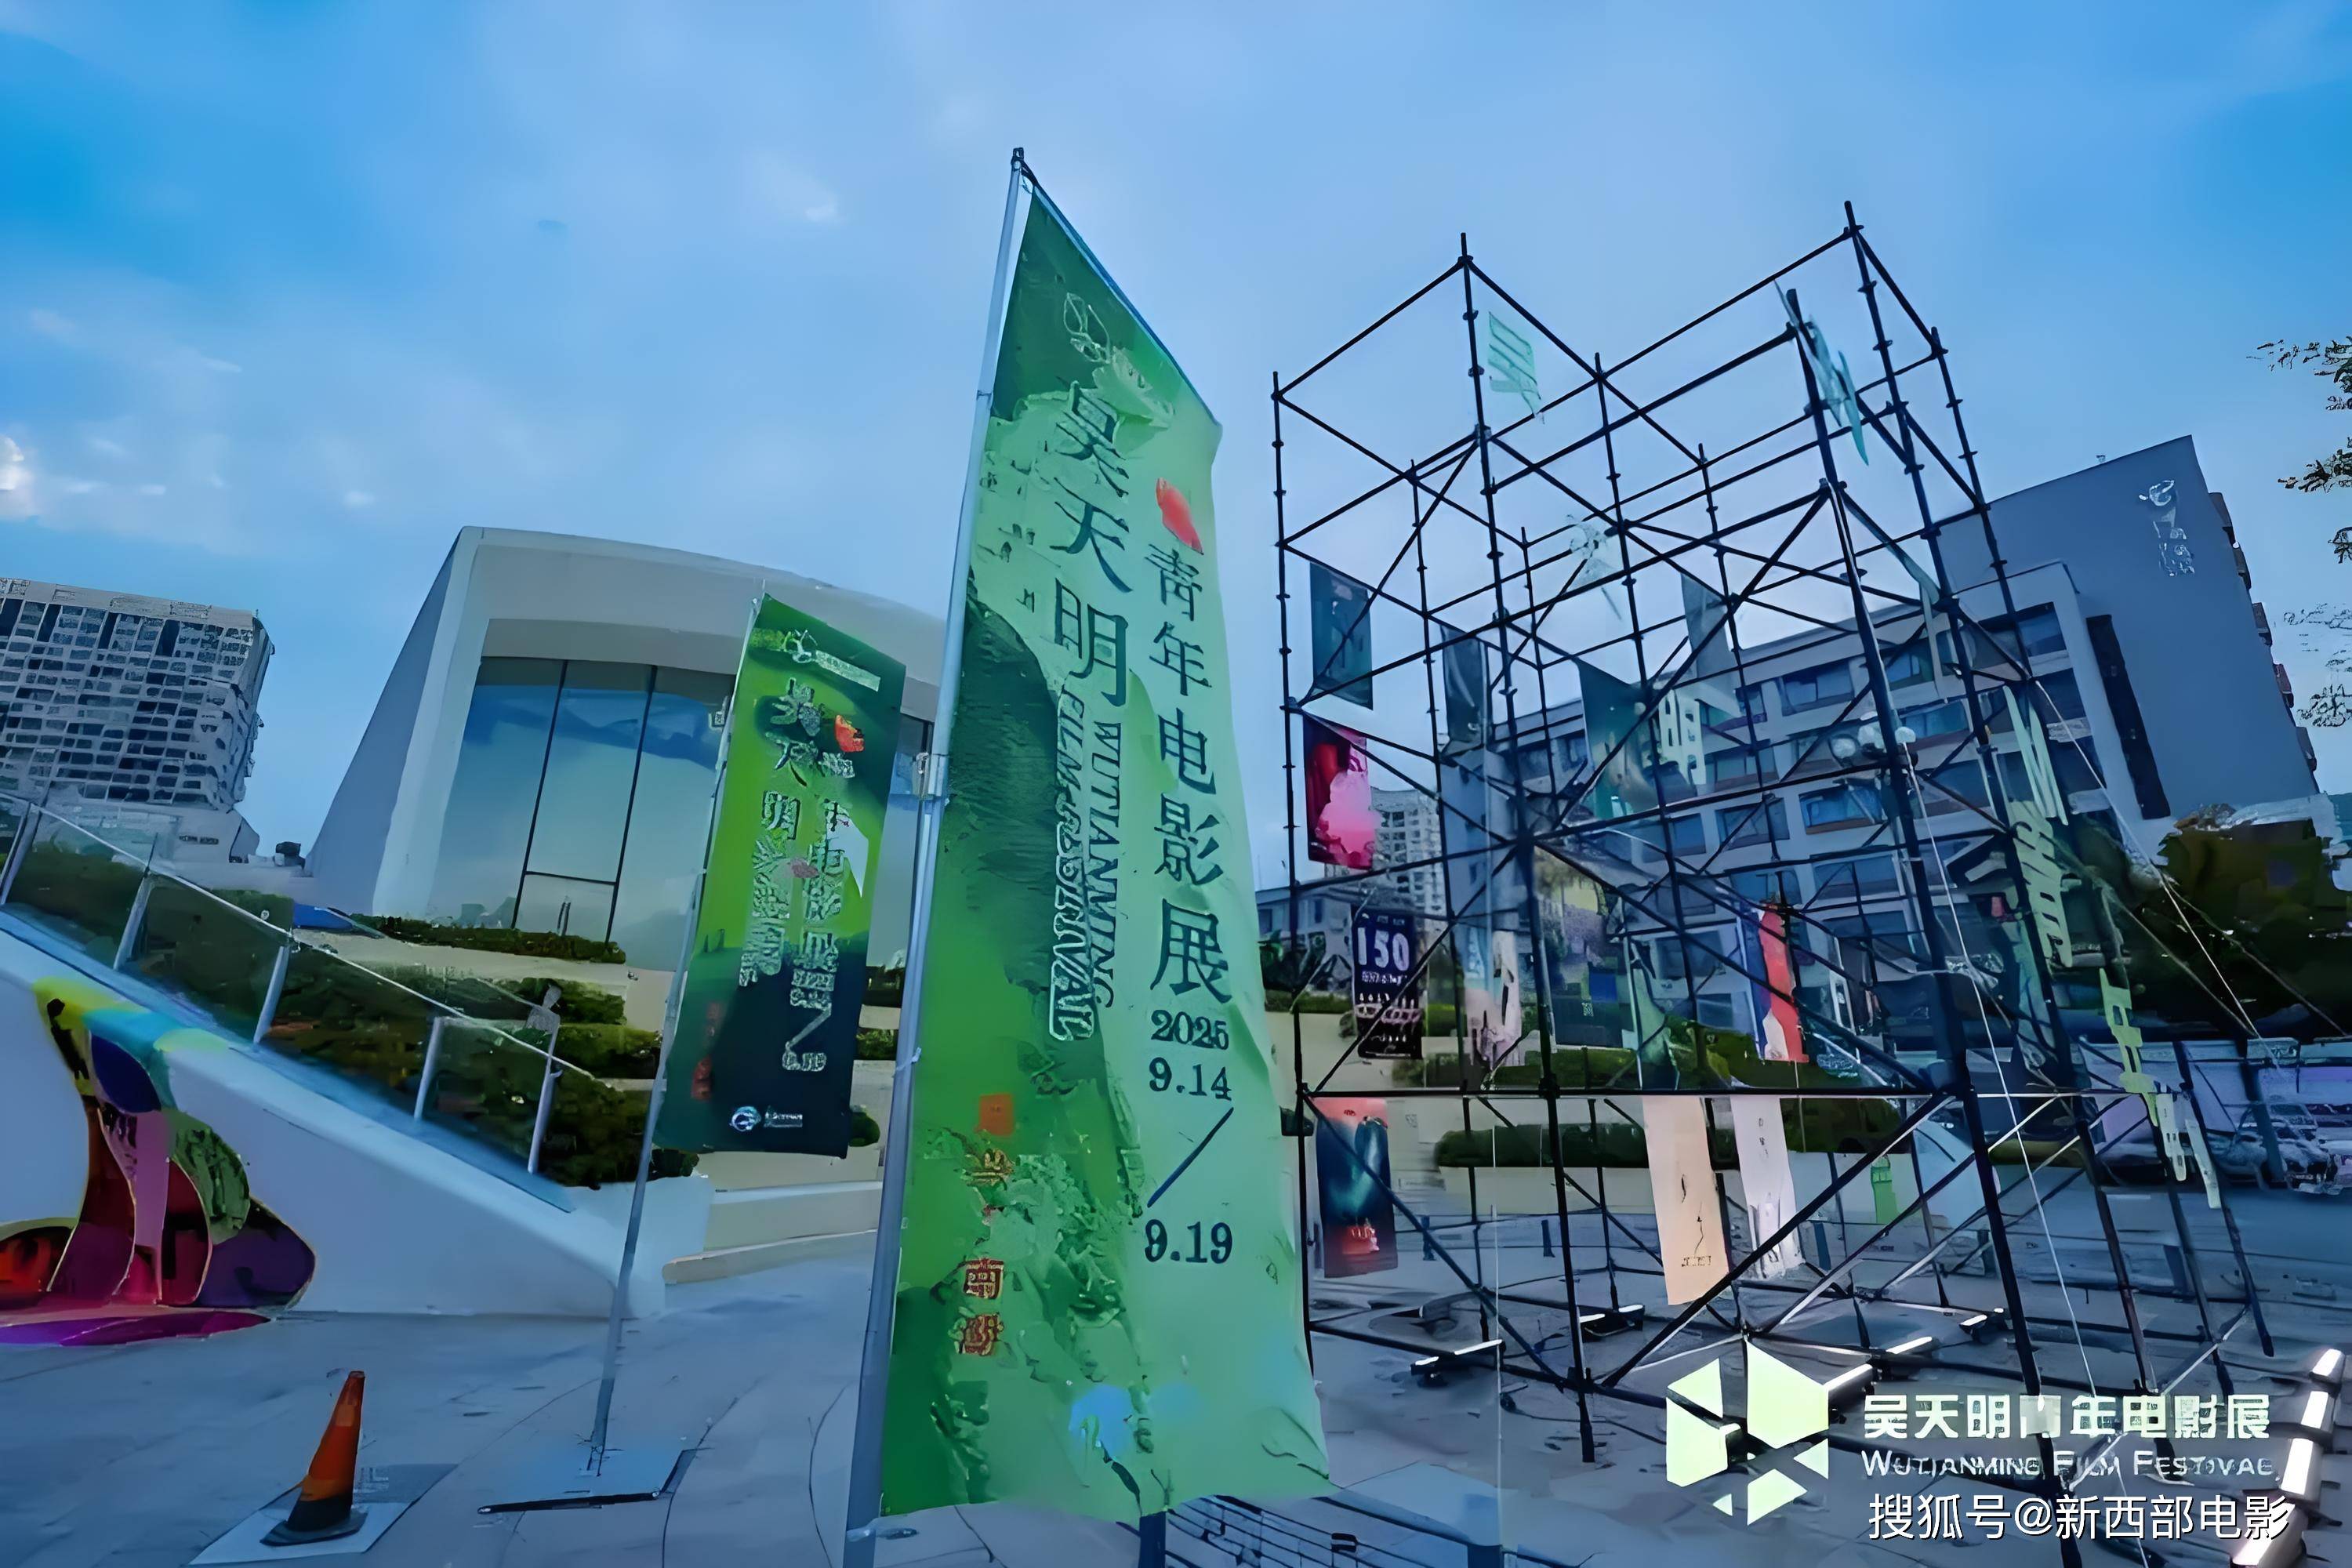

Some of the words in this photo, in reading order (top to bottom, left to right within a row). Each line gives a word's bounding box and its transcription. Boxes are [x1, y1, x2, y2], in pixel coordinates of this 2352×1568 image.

[1143, 543, 1232, 1004] 青年电影展
[1357, 927, 1410, 971] 150
[1151, 1009, 1229, 1050] 2025
[1149, 1057, 1232, 1101] 9.14
[1144, 1218, 1232, 1264] 9.19
